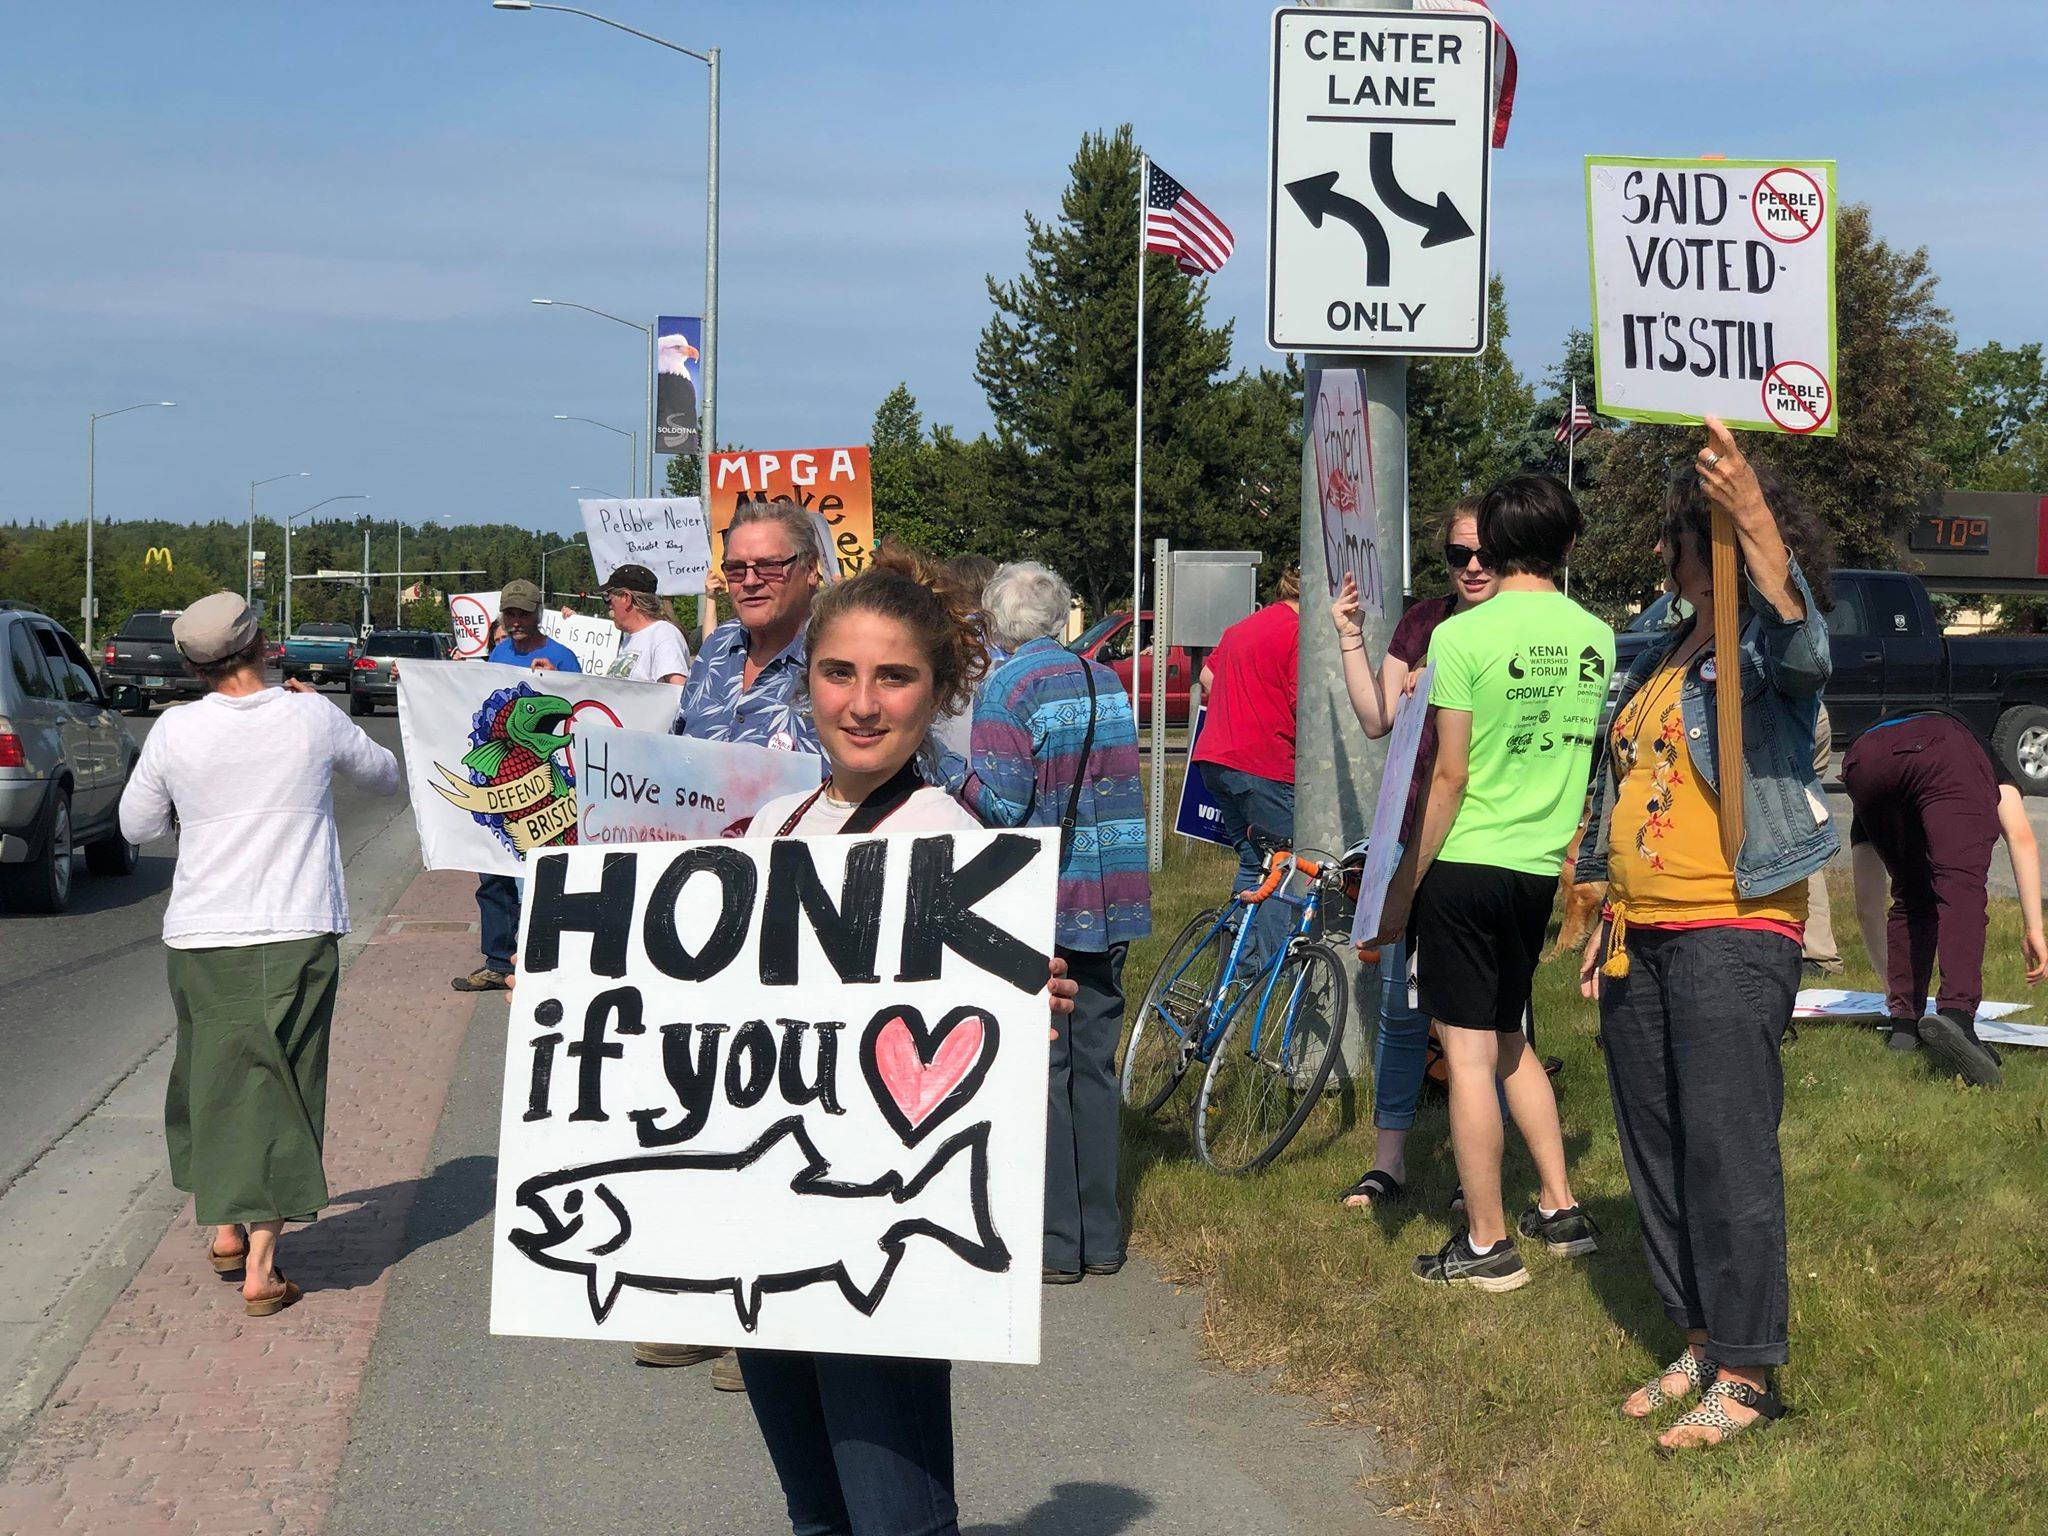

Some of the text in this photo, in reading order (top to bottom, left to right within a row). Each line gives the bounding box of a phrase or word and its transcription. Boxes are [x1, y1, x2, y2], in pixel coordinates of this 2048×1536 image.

[1304, 29, 1462, 64] CENTER
[1328, 75, 1435, 107] LANE
[1759, 192, 1816, 206] PEBBLE
[1767, 208, 1809, 222] MINE
[1327, 300, 1426, 332] ONLY
[1769, 382, 1825, 398] PEBBLE
[1776, 398, 1817, 413] MINE
[657, 426, 697, 435] SOLDOTNA
[717, 450, 856, 490] MPGA
[600, 506, 701, 533] Pebble Never
[569, 625, 579, 641] is
[585, 624, 612, 647] not
[1529, 645, 1568, 657] KENAI
[1531, 666, 1568, 677] FORUM
[1506, 685, 1564, 700] CROWLEY
[1562, 715, 1593, 725] SAFEWAY
[585, 738, 726, 812] Have some
[487, 774, 546, 810] DEFEND
[526, 797, 578, 841] BRISTO
[524, 833, 1051, 995] HONK
[523, 986, 848, 1148] if you
